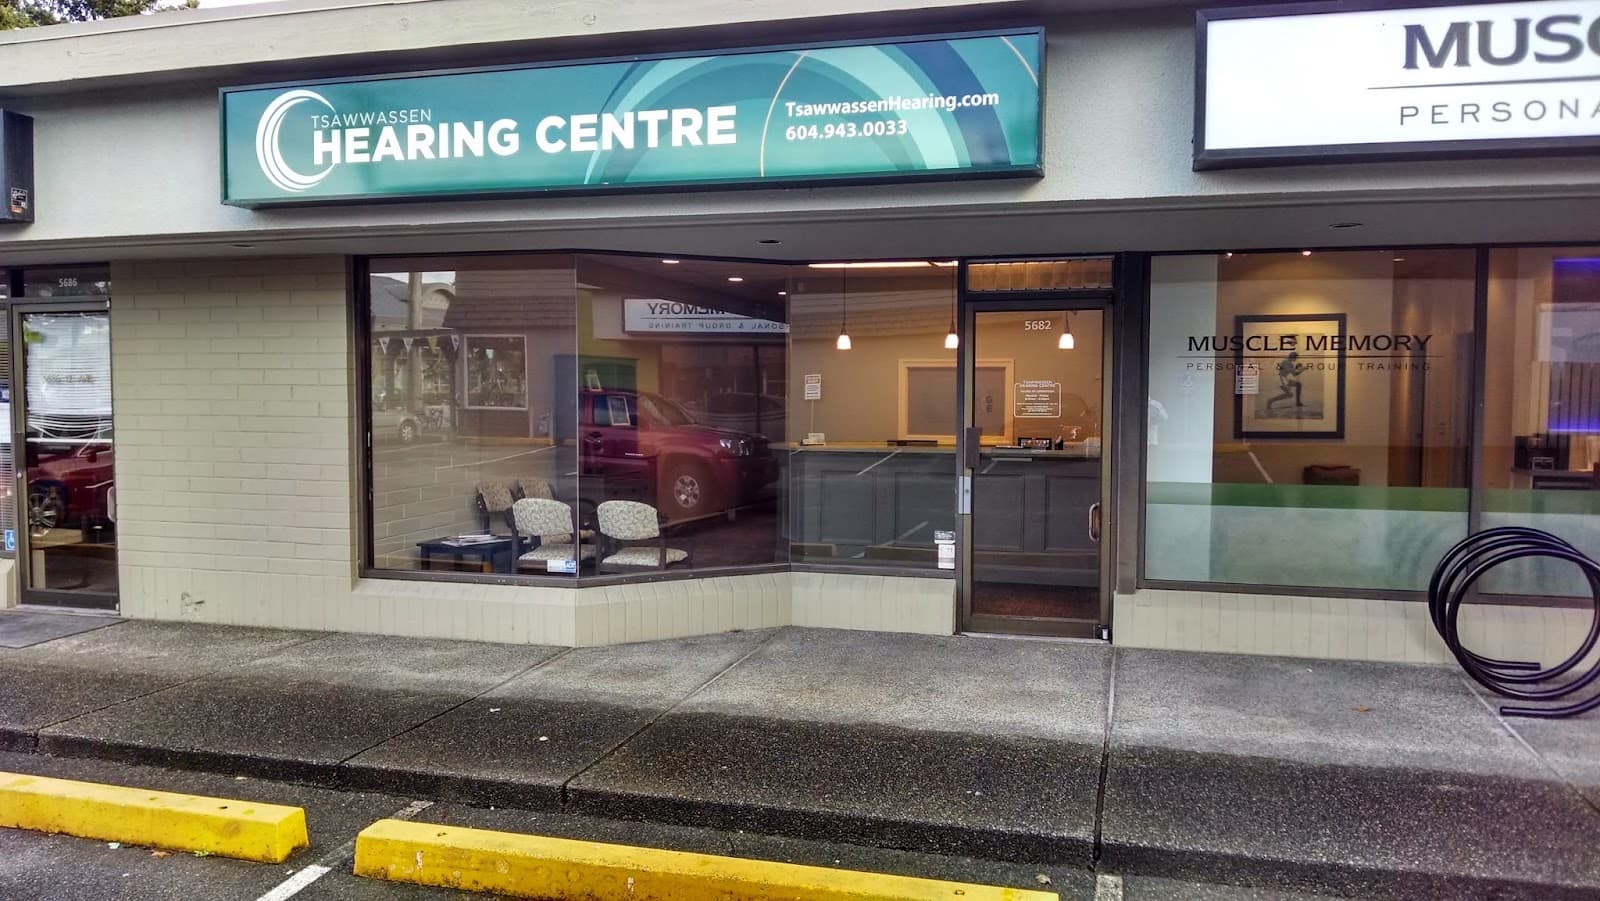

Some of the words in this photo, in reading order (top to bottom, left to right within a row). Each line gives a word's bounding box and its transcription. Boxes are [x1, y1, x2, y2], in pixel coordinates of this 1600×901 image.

[1402, 14, 1600, 70] MUS
[785, 92, 999, 117] TsawwassenHearing.com
[311, 108, 432, 128] TSAWWASSEN
[313, 118, 520, 165] HEARING
[535, 105, 737, 154] CENTRE
[785, 120, 908, 141] 604.943.0033
[58, 278, 78, 288] 5686
[1024, 320, 1052, 331] 5682
[1188, 335, 1297, 351] MUSCLE
[1306, 334, 1433, 351] MEMORY
[1186, 362, 1265, 371] PERSOAL
